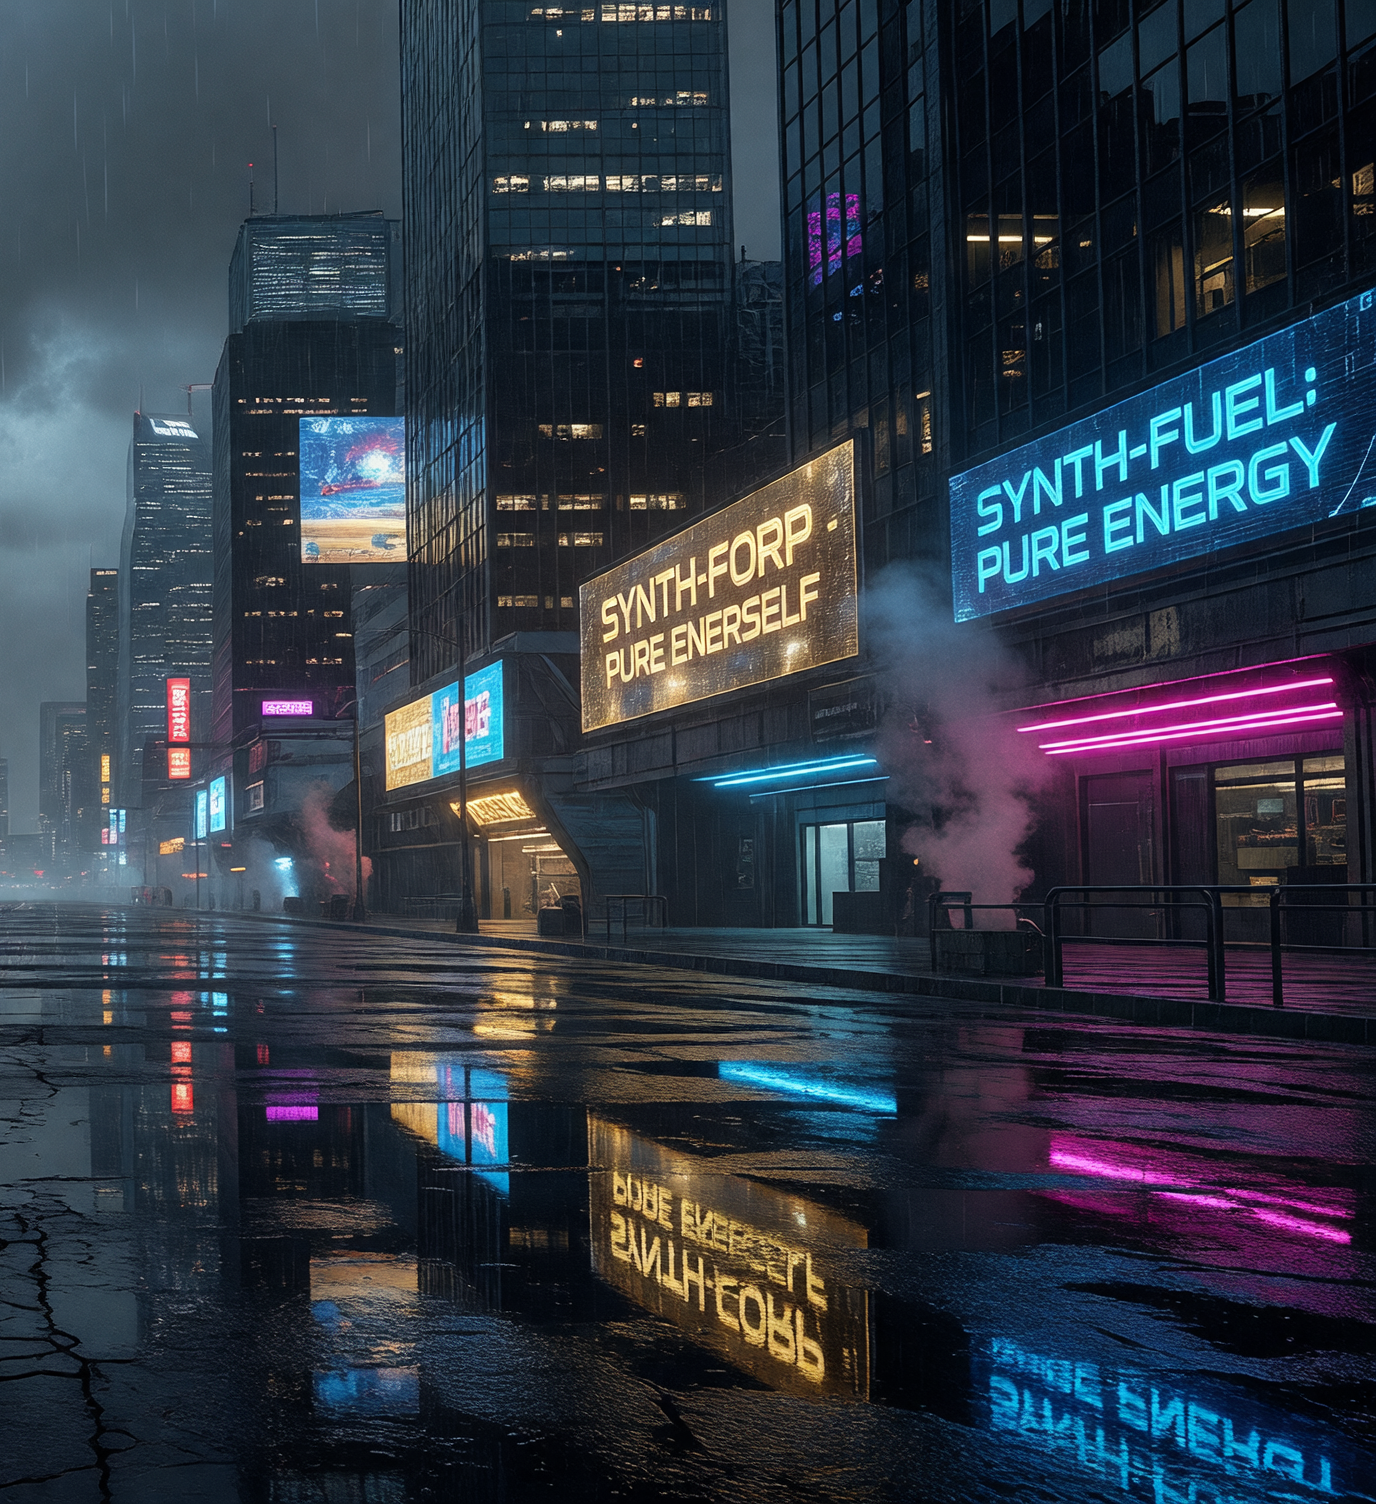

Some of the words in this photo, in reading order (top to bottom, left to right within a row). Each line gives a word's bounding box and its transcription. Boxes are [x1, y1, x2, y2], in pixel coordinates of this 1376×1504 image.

[977, 367, 1317, 537] SYNTH-FUEL:
[977, 512, 1090, 594] PURE
[1103, 421, 1337, 555] ENERGY
[601, 503, 812, 643] SYNTH-FORP
[605, 633, 666, 689] PURE
[671, 571, 821, 666] ENERSELF
